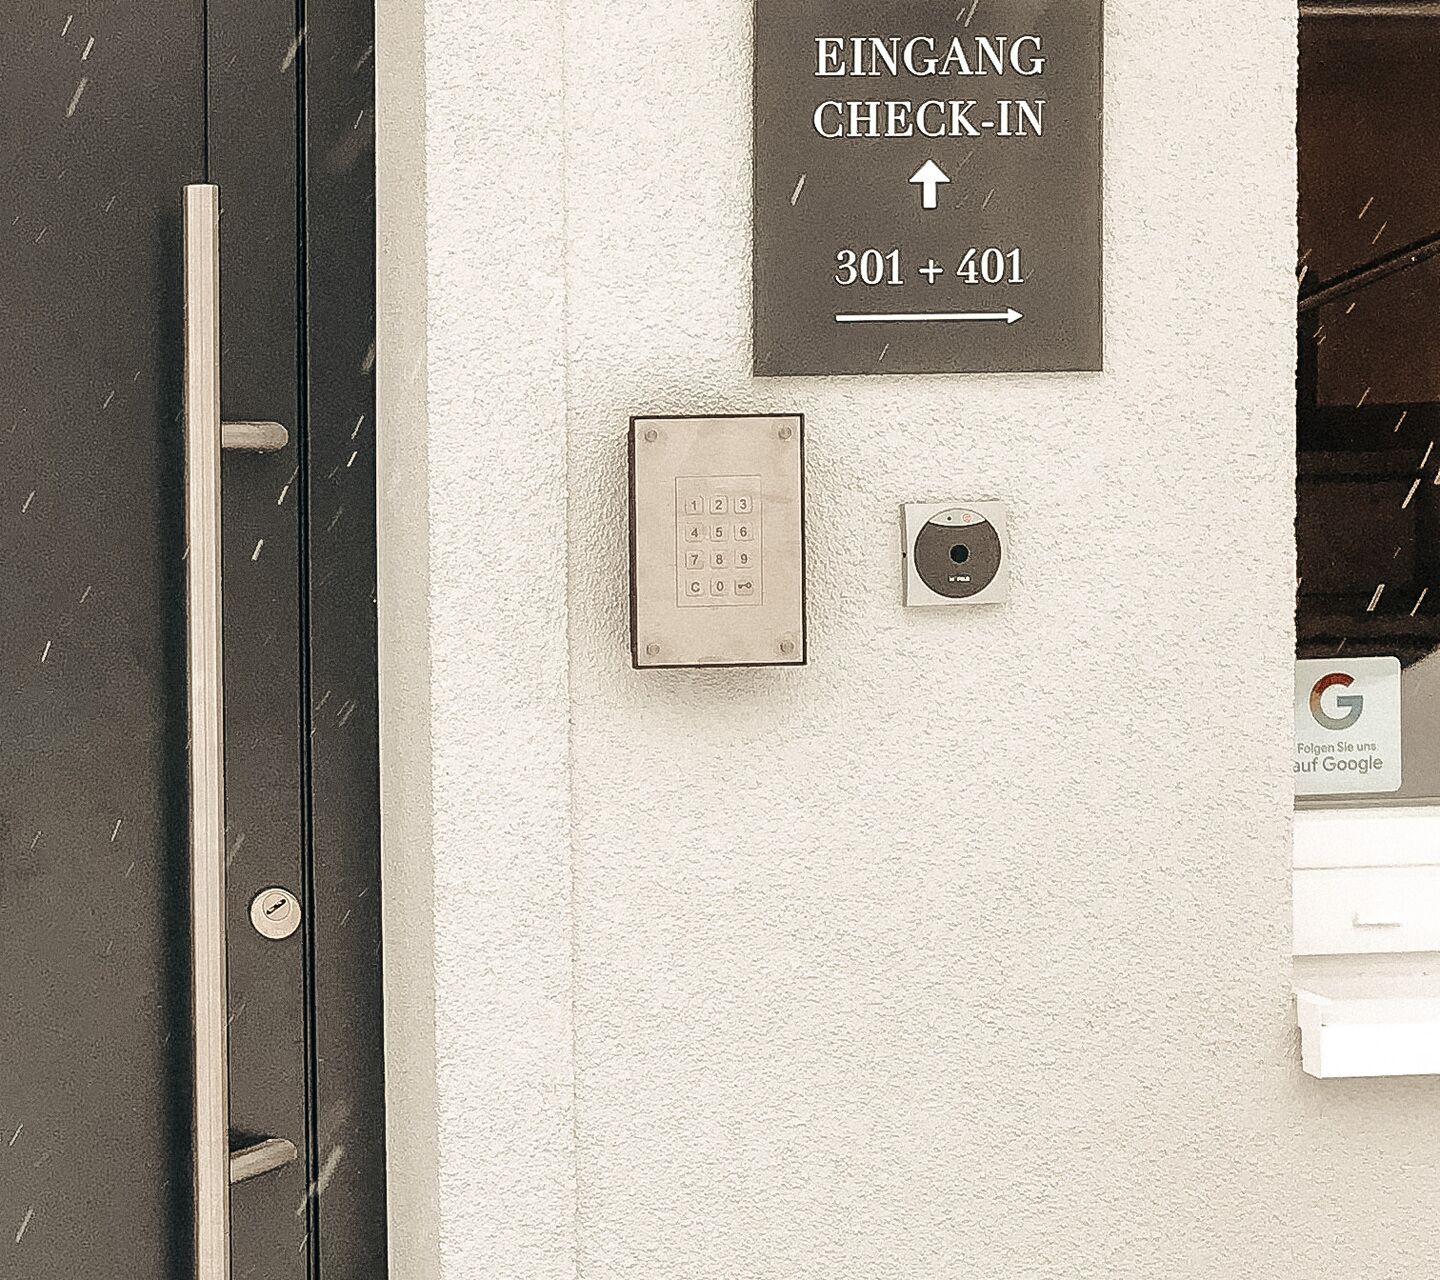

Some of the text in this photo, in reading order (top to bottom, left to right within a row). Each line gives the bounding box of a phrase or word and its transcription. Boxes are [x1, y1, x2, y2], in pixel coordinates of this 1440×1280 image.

[814, 35, 1046, 77] EINGANG
[812, 100, 1046, 138] CHECK-IN
[834, 248, 1024, 286] 301 + 401
[691, 498, 747, 511] 1 2 3
[690, 526, 748, 538] 4 5 6
[690, 553, 748, 566] 7 8 9
[690, 580, 724, 593] C 0
[1309, 672, 1364, 731] G
[1297, 741, 1377, 755] Folgen Sie uns
[1292, 755, 1384, 775] auf Google
